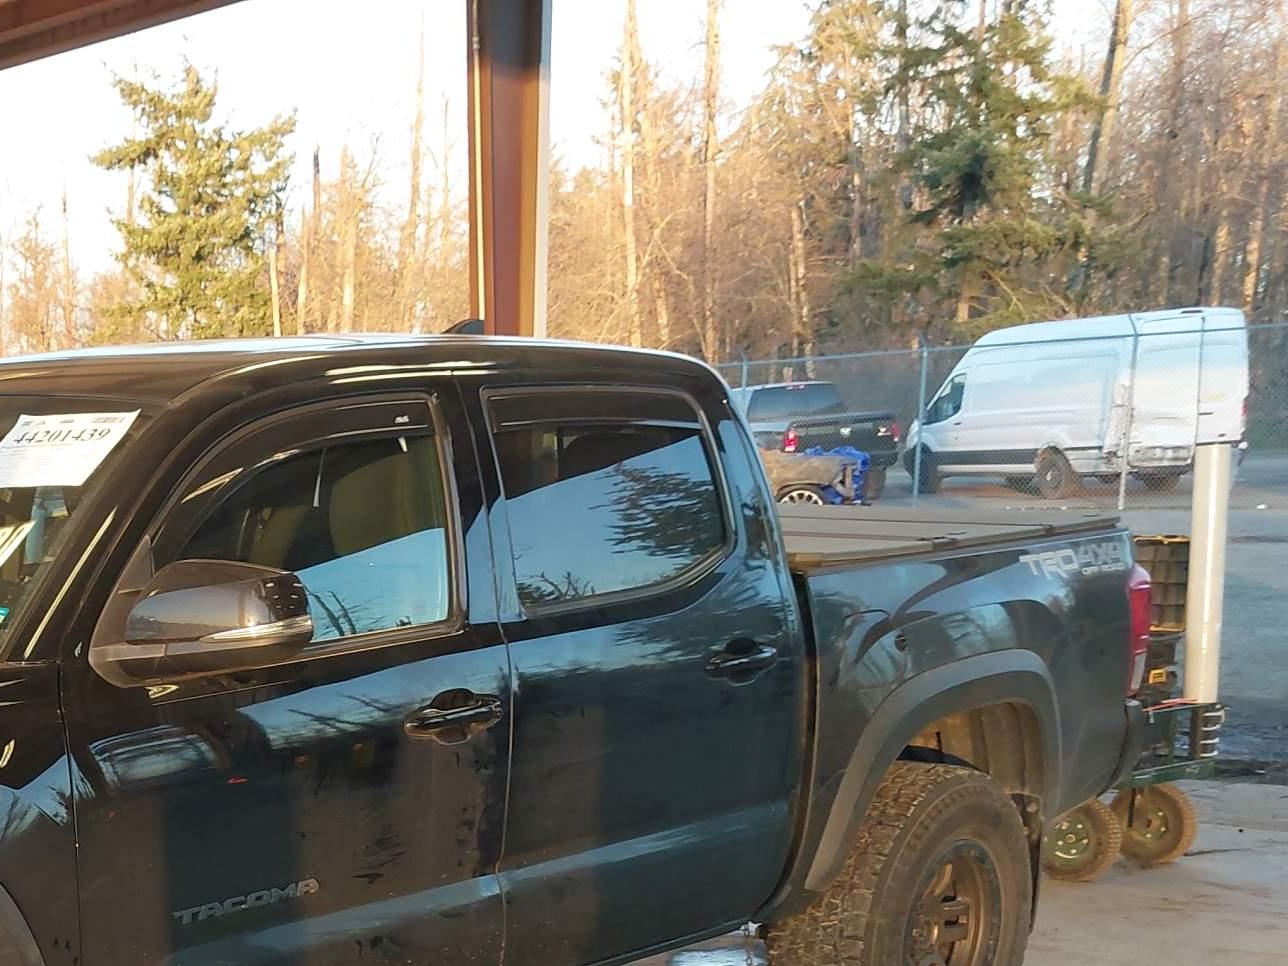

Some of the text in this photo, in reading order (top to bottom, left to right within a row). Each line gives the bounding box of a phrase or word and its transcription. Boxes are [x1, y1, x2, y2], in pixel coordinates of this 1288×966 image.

[13, 427, 112, 444] 44201439
[1018, 548, 1079, 579] TRD
[172, 878, 320, 926] TACOMA
